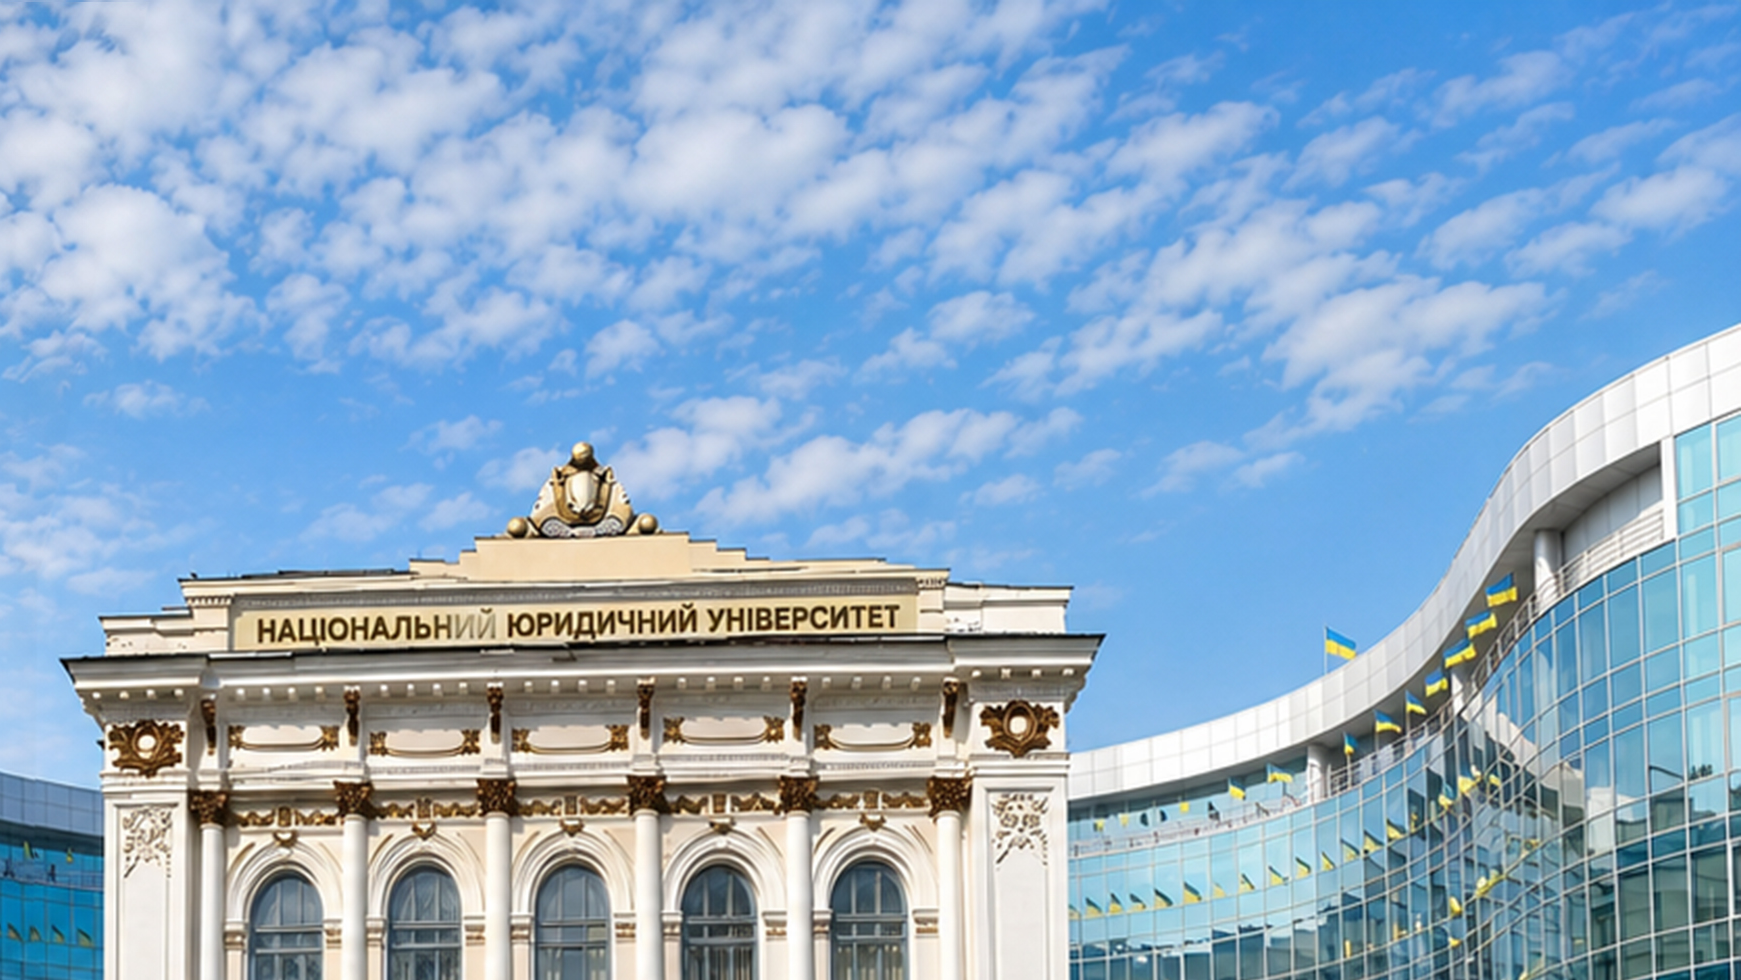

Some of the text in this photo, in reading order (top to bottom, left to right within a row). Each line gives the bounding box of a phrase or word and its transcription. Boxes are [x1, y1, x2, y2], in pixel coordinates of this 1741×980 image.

[257, 603, 901, 645] НАЦІОНАЛЬНИЙ ЮРИДИЧНИЙ УНІВЕРСИТЕТ
